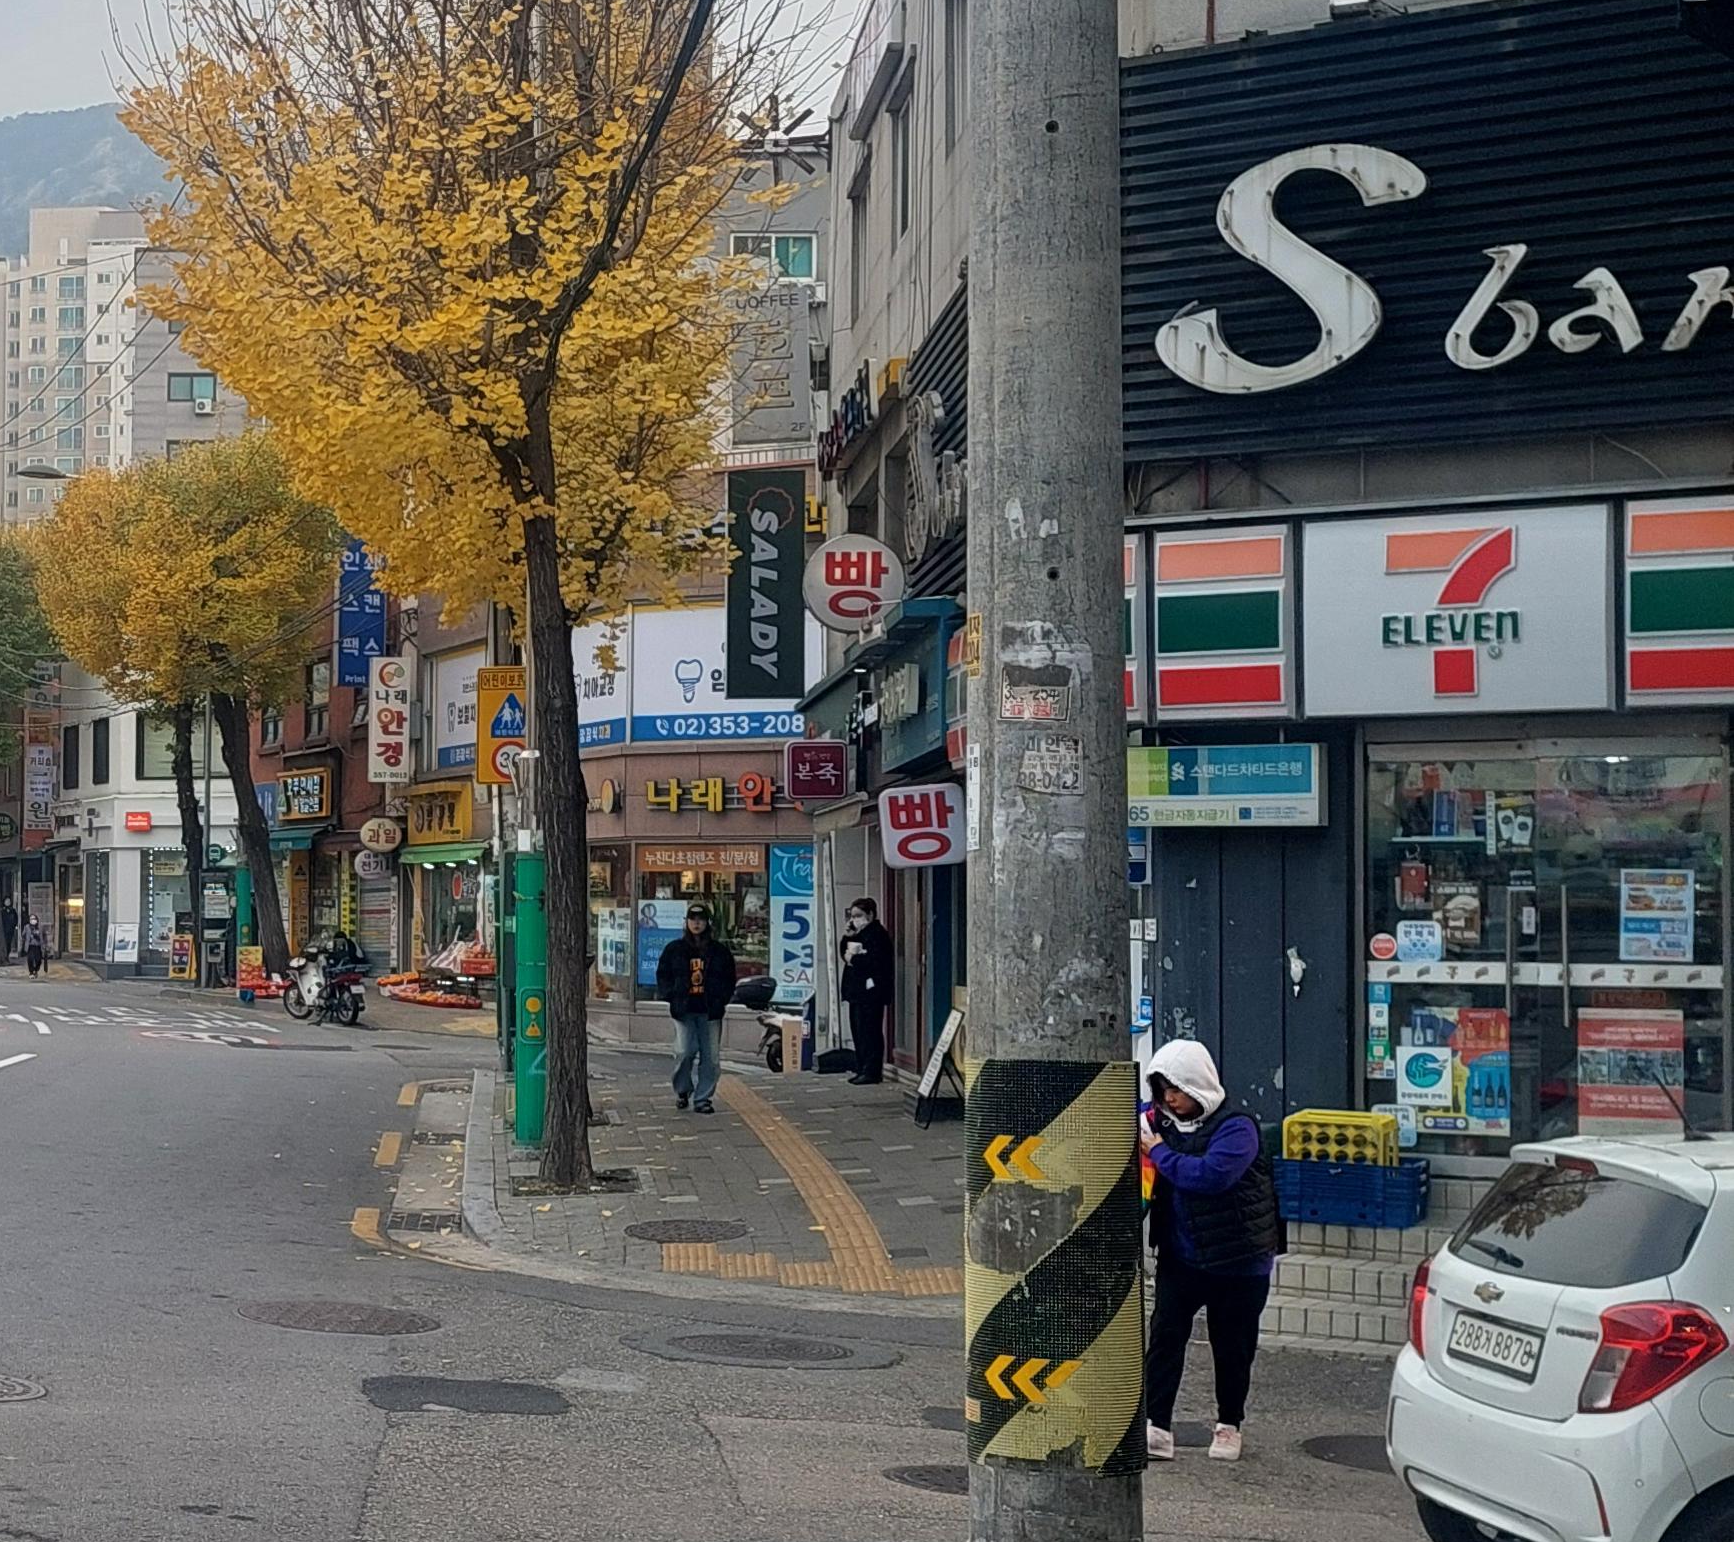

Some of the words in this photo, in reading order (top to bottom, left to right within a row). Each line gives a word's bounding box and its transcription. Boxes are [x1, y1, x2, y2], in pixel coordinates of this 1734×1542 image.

[1155, 143, 1429, 395] S
[750, 507, 780, 680] SALADY
[825, 551, 890, 619] 빵
[482, 672, 524, 688] 어린이보호
[674, 715, 806, 736] 02)353-208
[793, 762, 842, 786] 본죽
[1129, 806, 1150, 822] 65
[367, 827, 398, 845] 과일
[887, 790, 955, 861] 빵
[782, 968, 811, 984] SA
